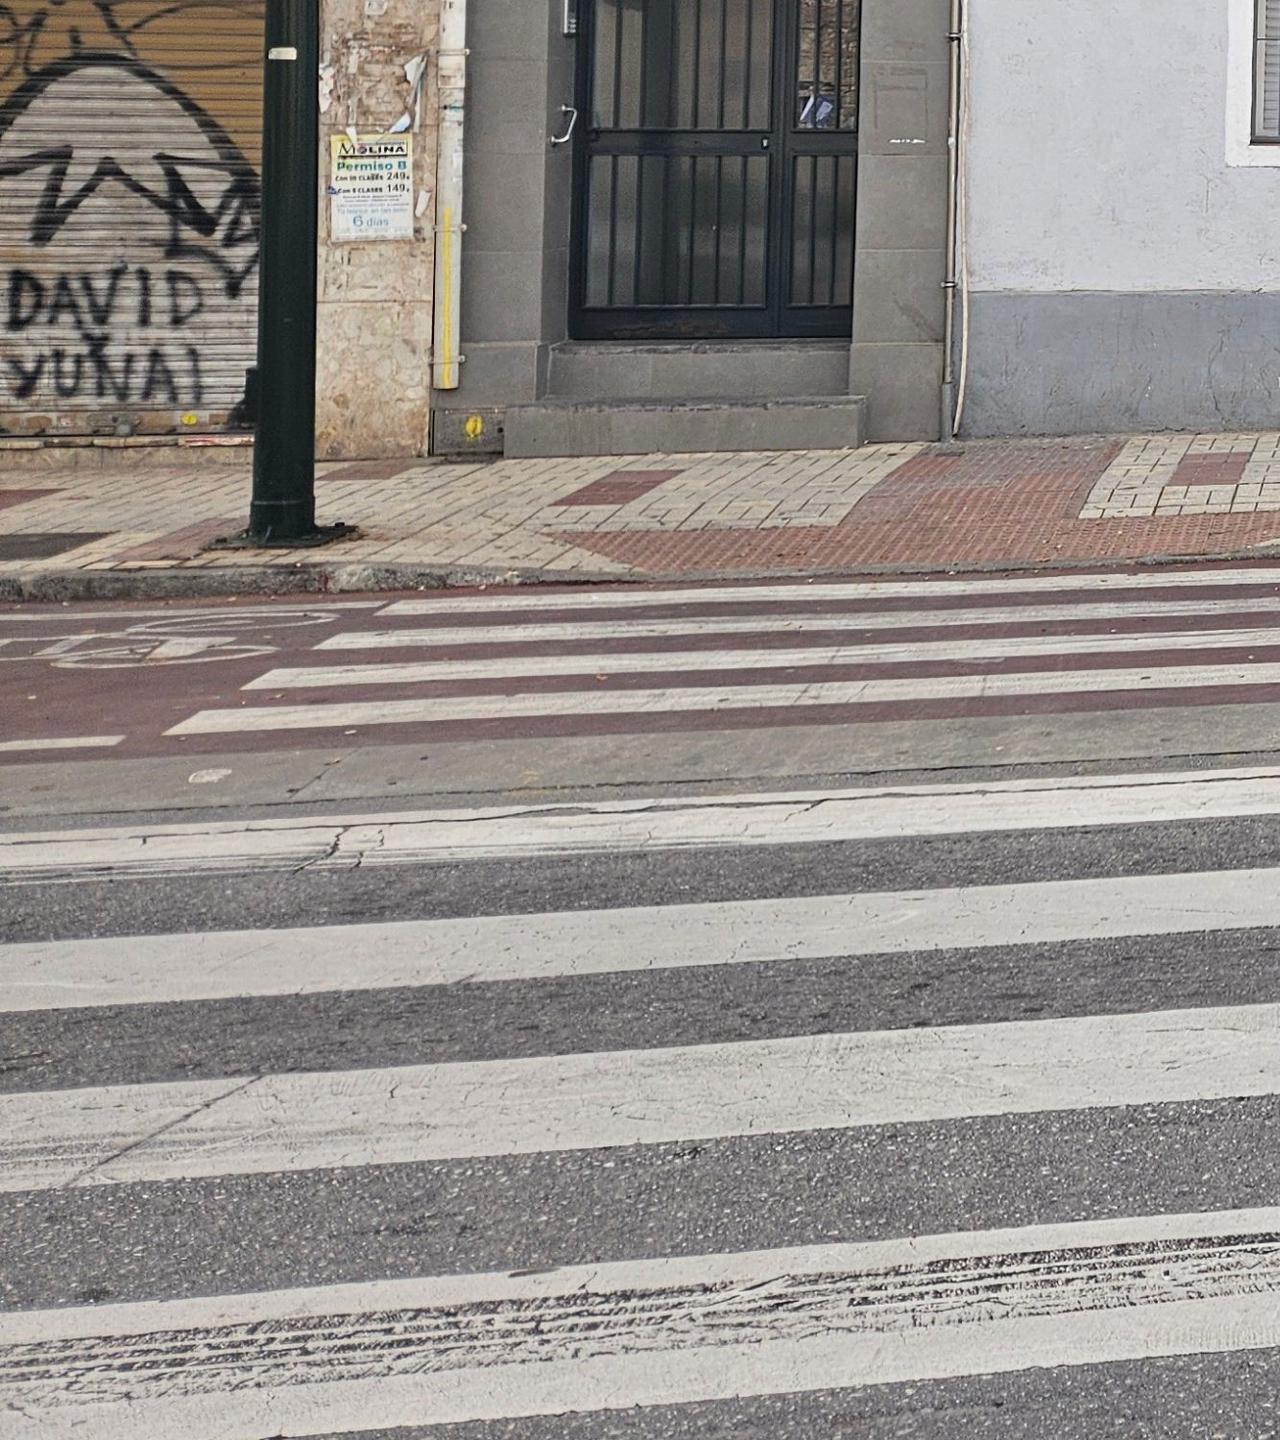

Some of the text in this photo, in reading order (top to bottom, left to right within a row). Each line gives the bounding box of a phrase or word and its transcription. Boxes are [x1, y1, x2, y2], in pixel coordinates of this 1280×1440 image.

[336, 161, 393, 171] Permiso
[353, 215, 363, 227] 6
[8, 261, 205, 331] DAVID
